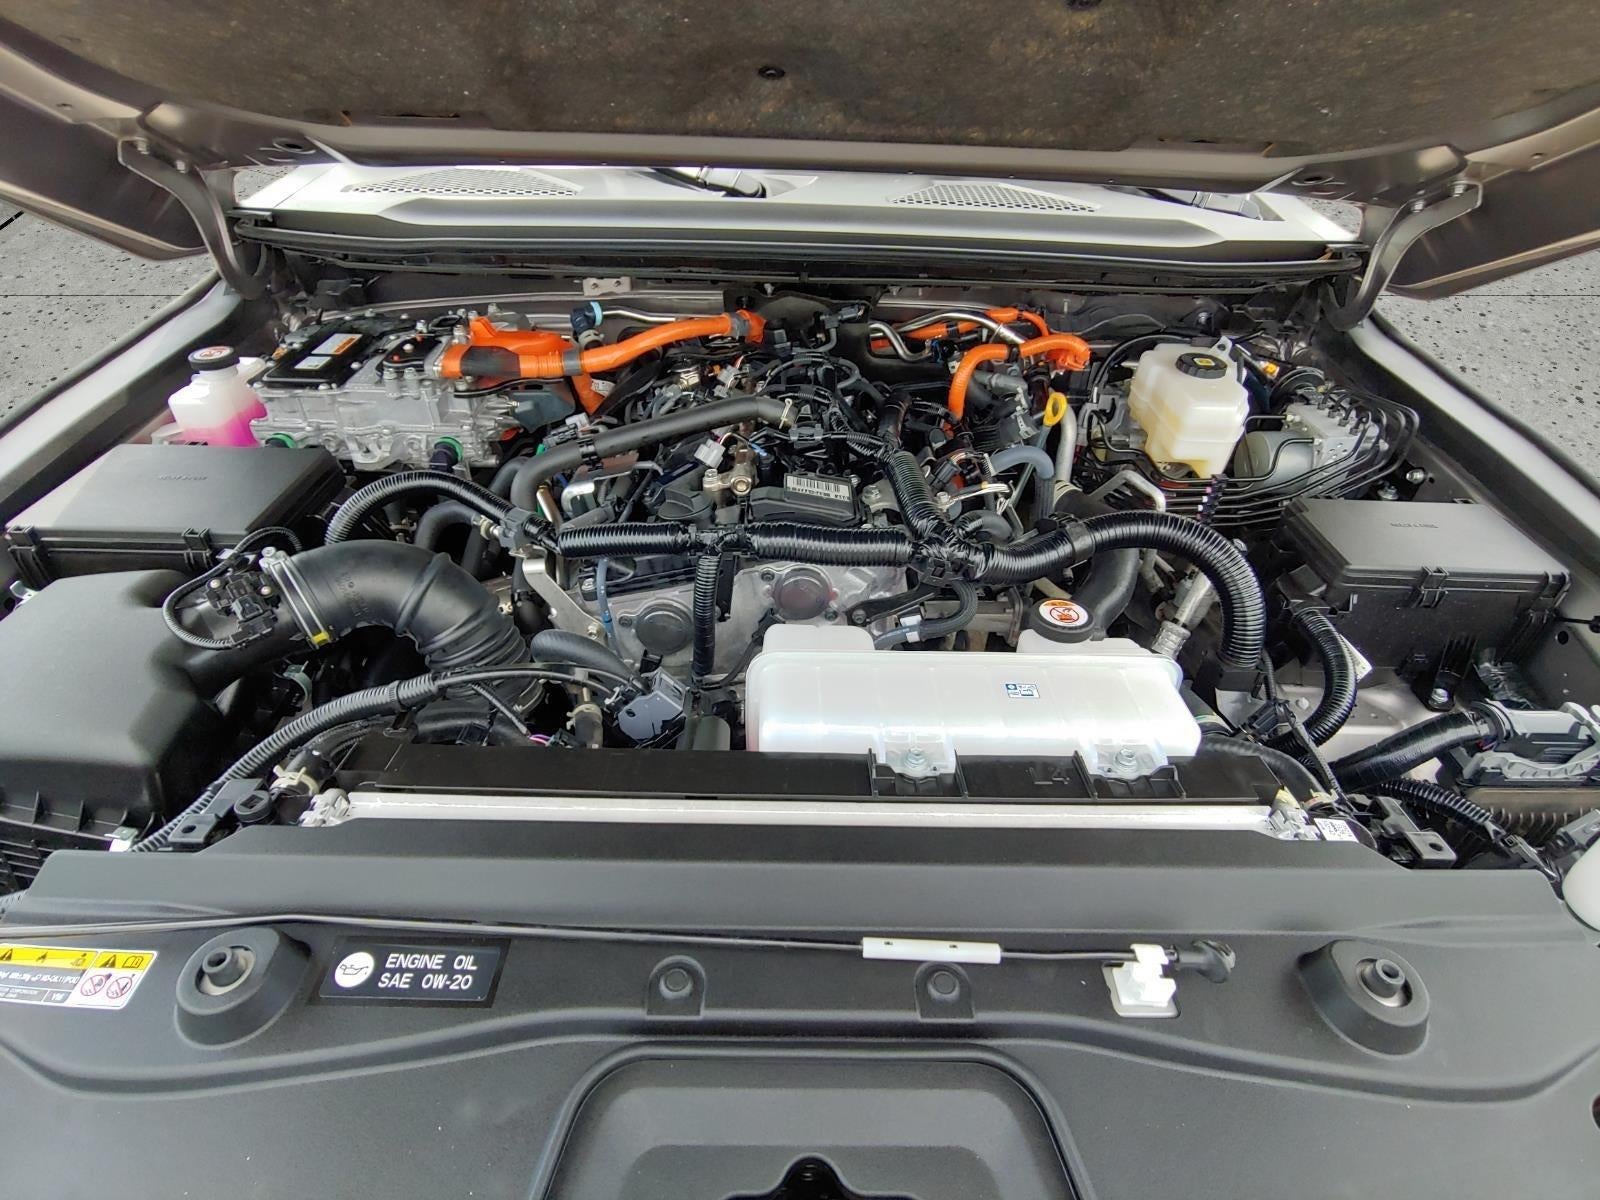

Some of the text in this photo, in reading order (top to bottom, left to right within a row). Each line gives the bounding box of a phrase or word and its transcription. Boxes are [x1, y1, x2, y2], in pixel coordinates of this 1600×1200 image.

[385, 953, 478, 971] ENGINE OIL
[378, 973, 473, 990] SAE 0W-20
